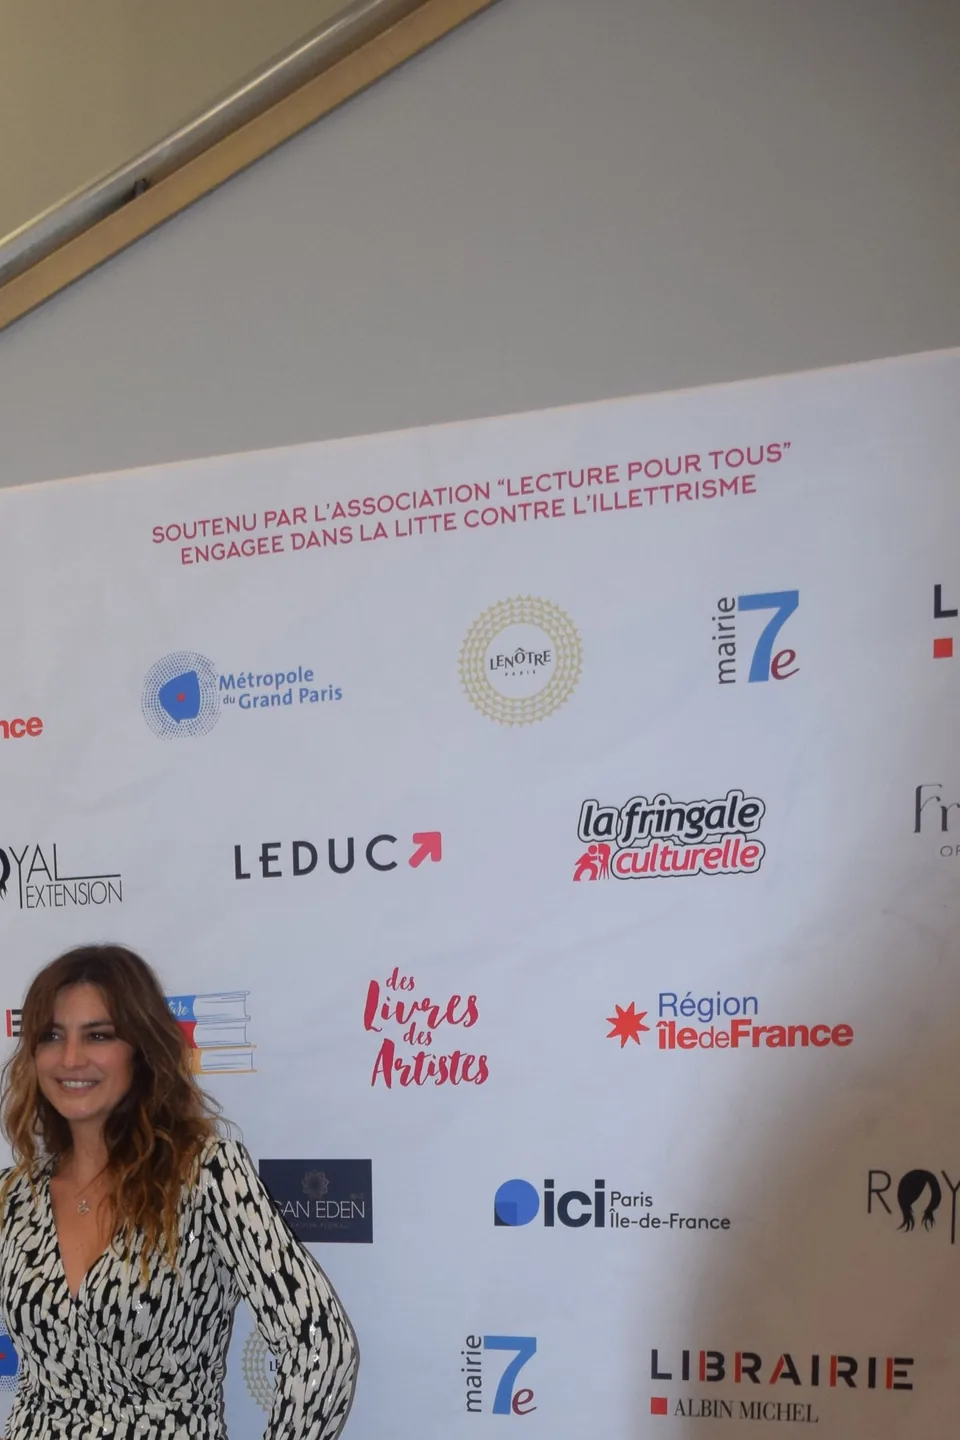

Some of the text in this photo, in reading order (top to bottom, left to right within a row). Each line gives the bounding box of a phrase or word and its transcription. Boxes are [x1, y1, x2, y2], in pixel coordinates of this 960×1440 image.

[153, 513, 256, 543] SOUTENU
[265, 507, 307, 528] PAR
[628, 454, 701, 480] POUR
[181, 535, 284, 565] ENGAGEE
[290, 526, 353, 550] DANS
[360, 522, 388, 541] LA
[396, 513, 457, 537] LITTE
[464, 499, 565, 528] CONTRE
[712, 590, 799, 684] mairie 7e
[490, 648, 550, 670] LENÔTRE
[219, 666, 313, 691] Métropole
[223, 685, 342, 709] du Grand Paris
[583, 795, 760, 843] la fringale
[234, 834, 397, 879] LEDUC
[616, 838, 760, 874] culturelle
[26, 880, 122, 908] EXTENSION
[386, 967, 414, 991] des
[364, 980, 478, 1032] Livres
[659, 991, 758, 1023] Région
[403, 1022, 432, 1046] des
[371, 1037, 488, 1089] Artistes
[315, 1200, 365, 1220] EDEN
[544, 1179, 605, 1227] ici
[611, 1191, 653, 1207] Paris
[609, 1208, 730, 1229] Île-de-France
[461, 1335, 537, 1415] mairie 7e
[651, 1349, 914, 1390] LIBRAIRIE
[675, 1399, 818, 1422] ALBIN MICHEL
